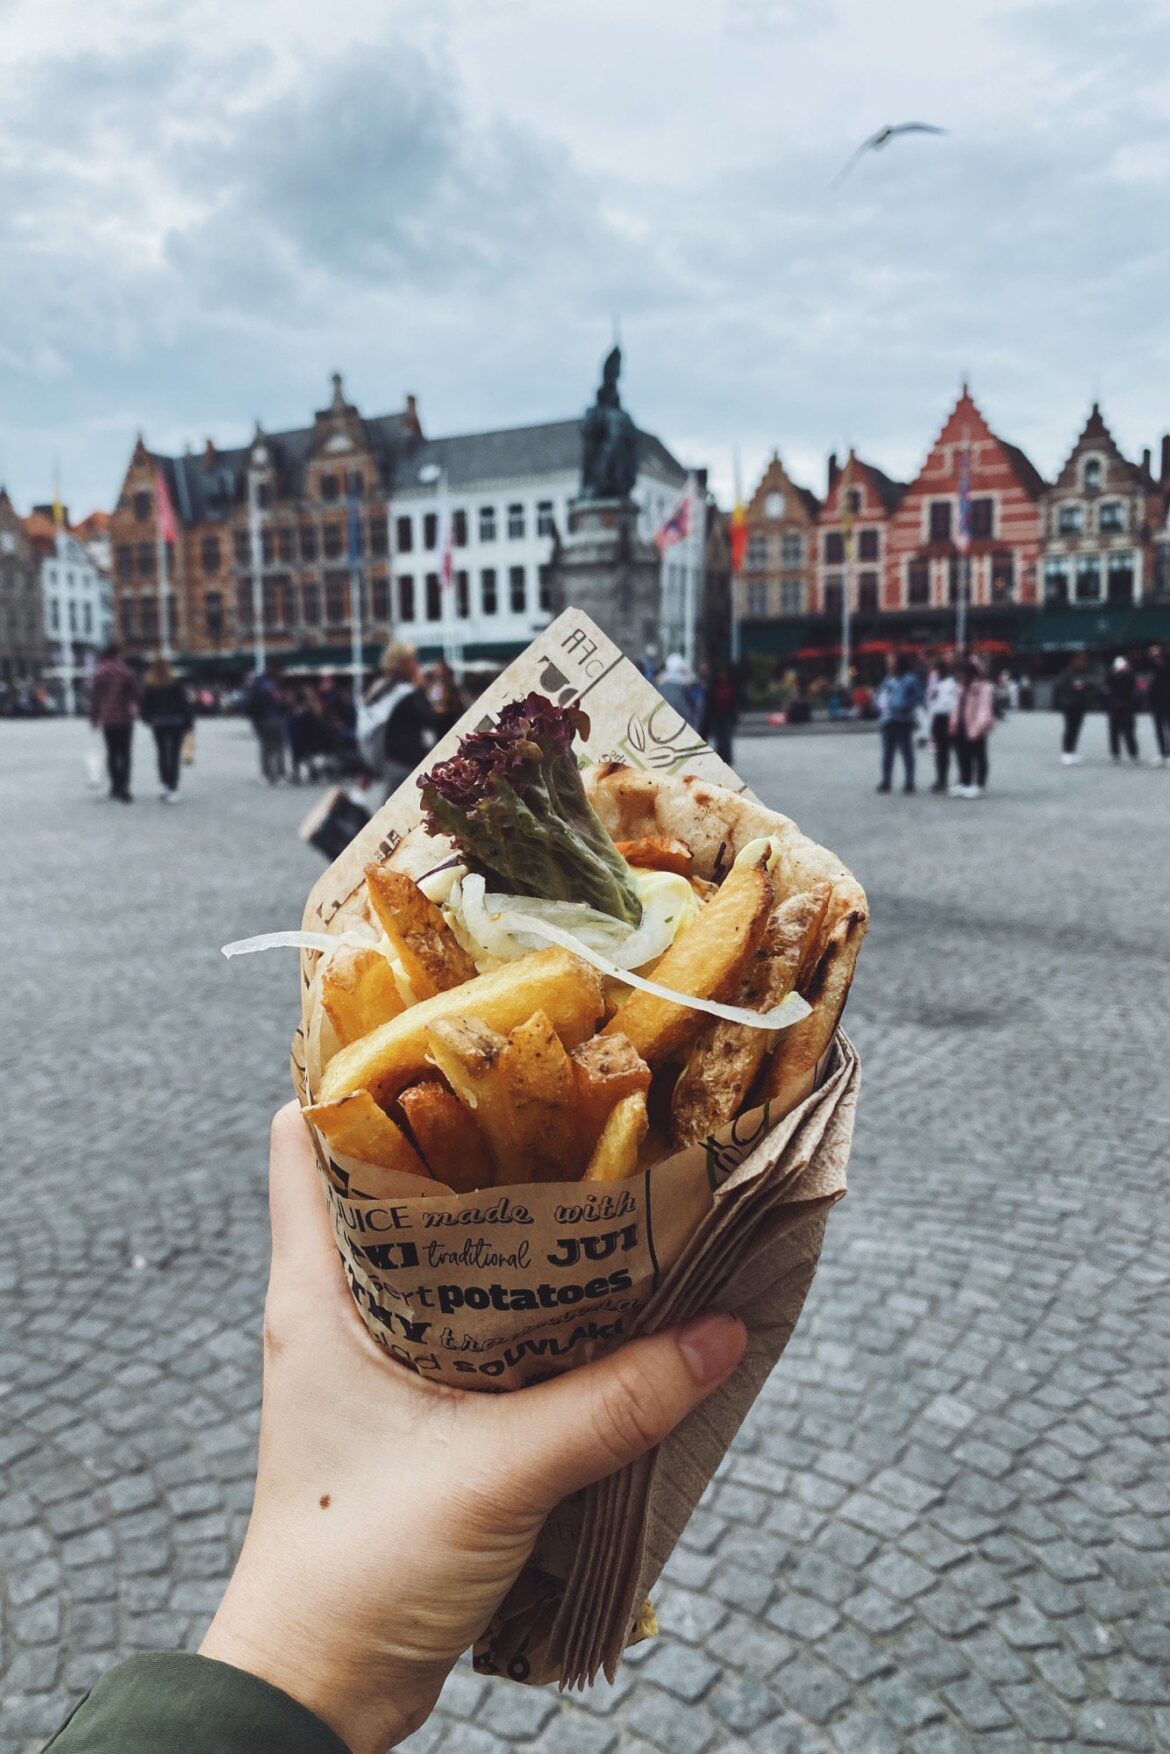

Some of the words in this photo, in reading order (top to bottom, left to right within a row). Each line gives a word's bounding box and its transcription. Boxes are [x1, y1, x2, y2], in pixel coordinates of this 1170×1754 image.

[423, 1197, 535, 1228] made
[554, 1190, 636, 1223] with
[422, 1237, 532, 1269] traditional
[437, 1267, 634, 1314] potatoes
